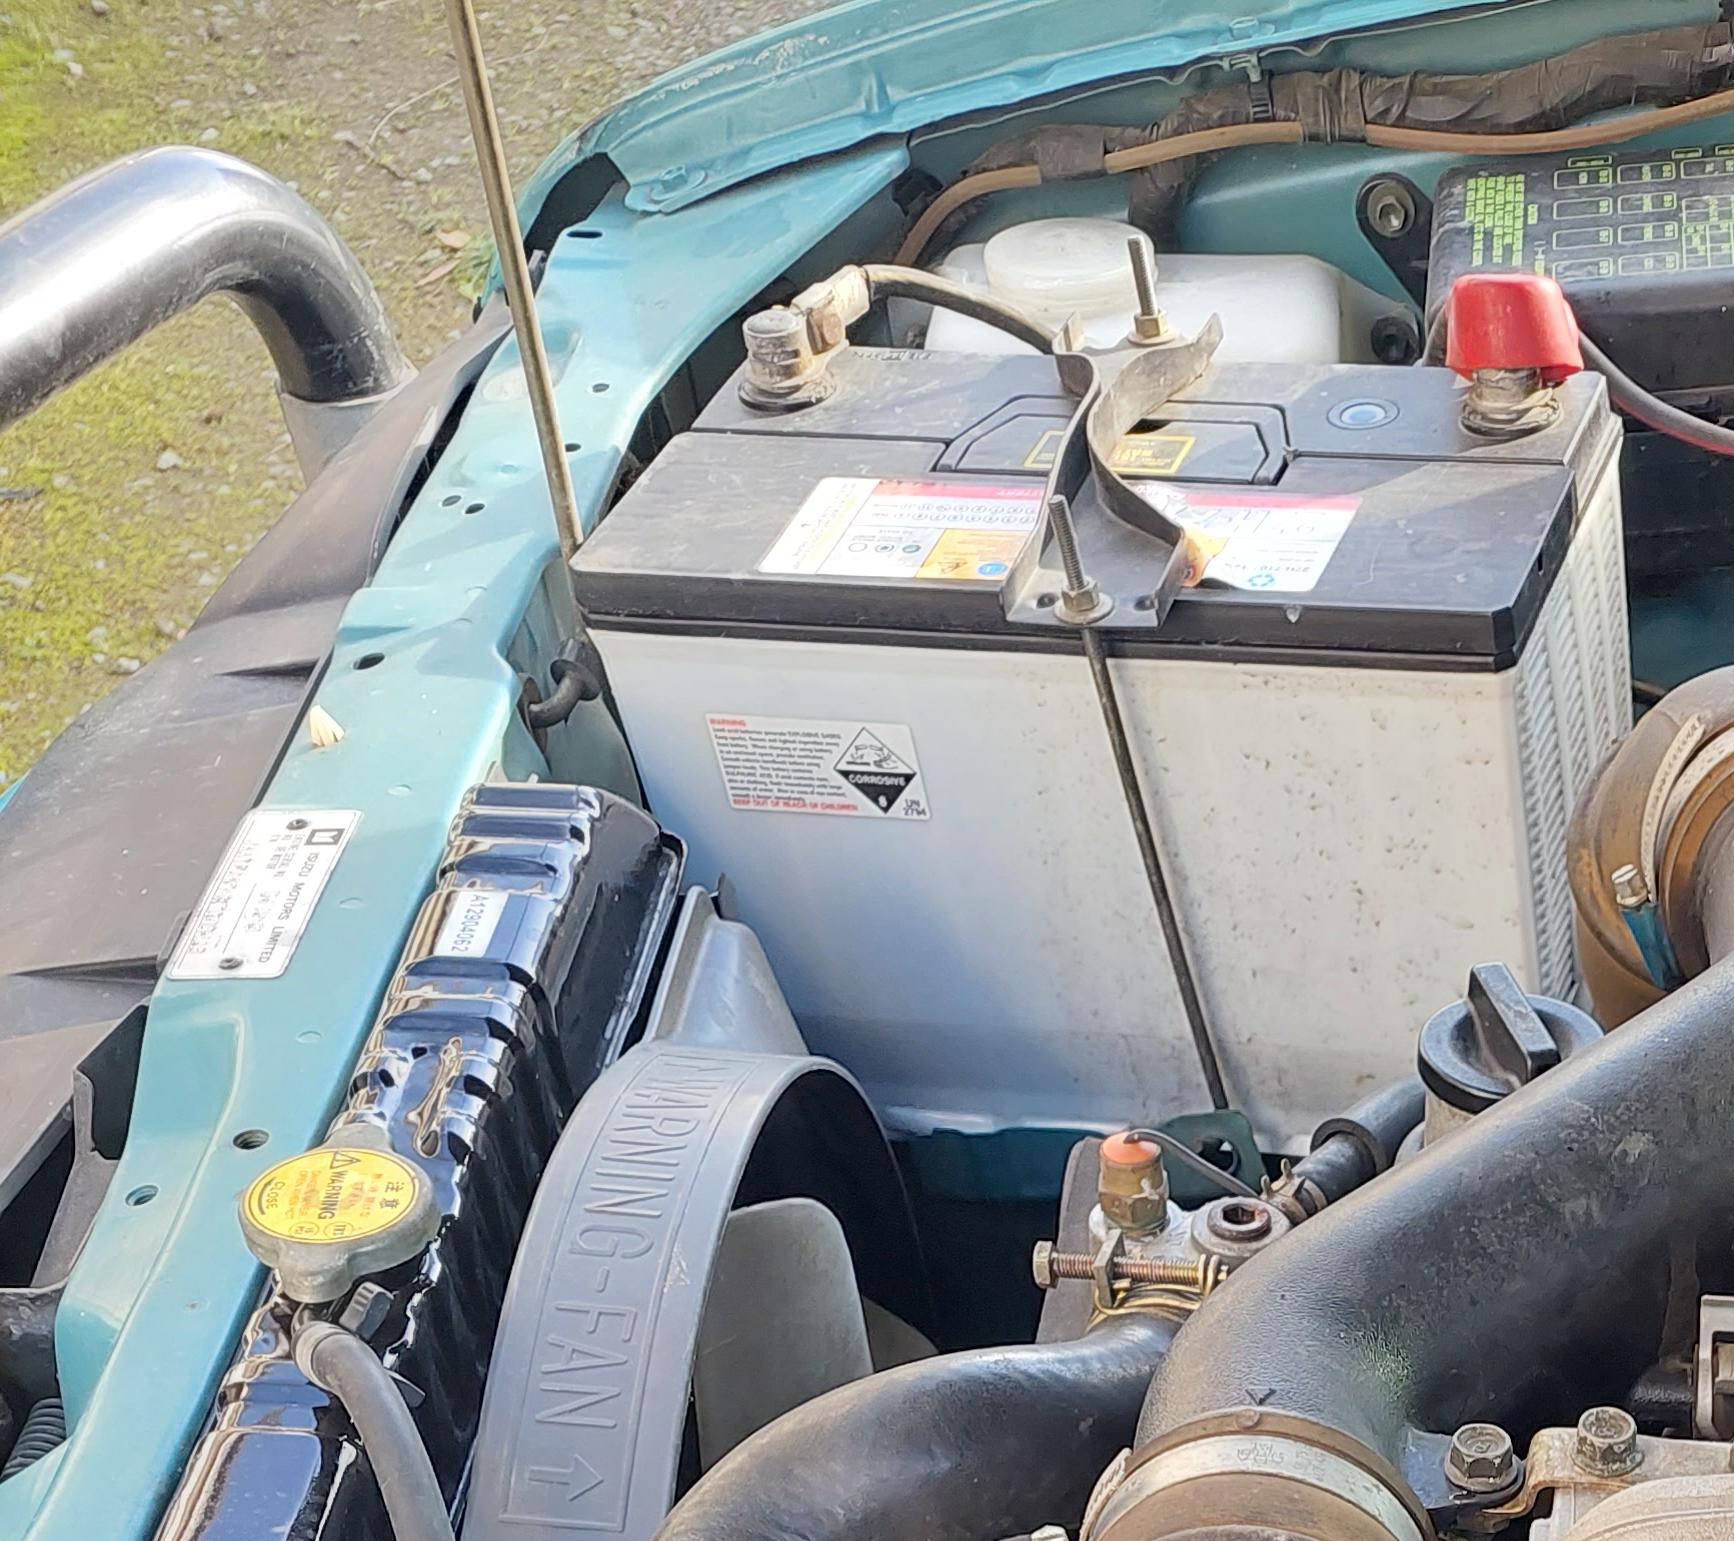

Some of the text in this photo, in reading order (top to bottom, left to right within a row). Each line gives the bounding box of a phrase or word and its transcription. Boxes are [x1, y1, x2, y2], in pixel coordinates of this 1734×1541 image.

[849, 774, 907, 787] CORROSIVE
[878, 795, 889, 808] 8
[903, 806, 927, 817] 2794
[905, 799, 920, 809] UN
[299, 852, 320, 877] ISUZU
[278, 882, 305, 921] MOTORS
[451, 894, 490, 953] A12904062
[258, 926, 284, 963] LIMITED
[265, 1181, 286, 1210] CLOSE
[317, 1170, 349, 1221] WARNING
